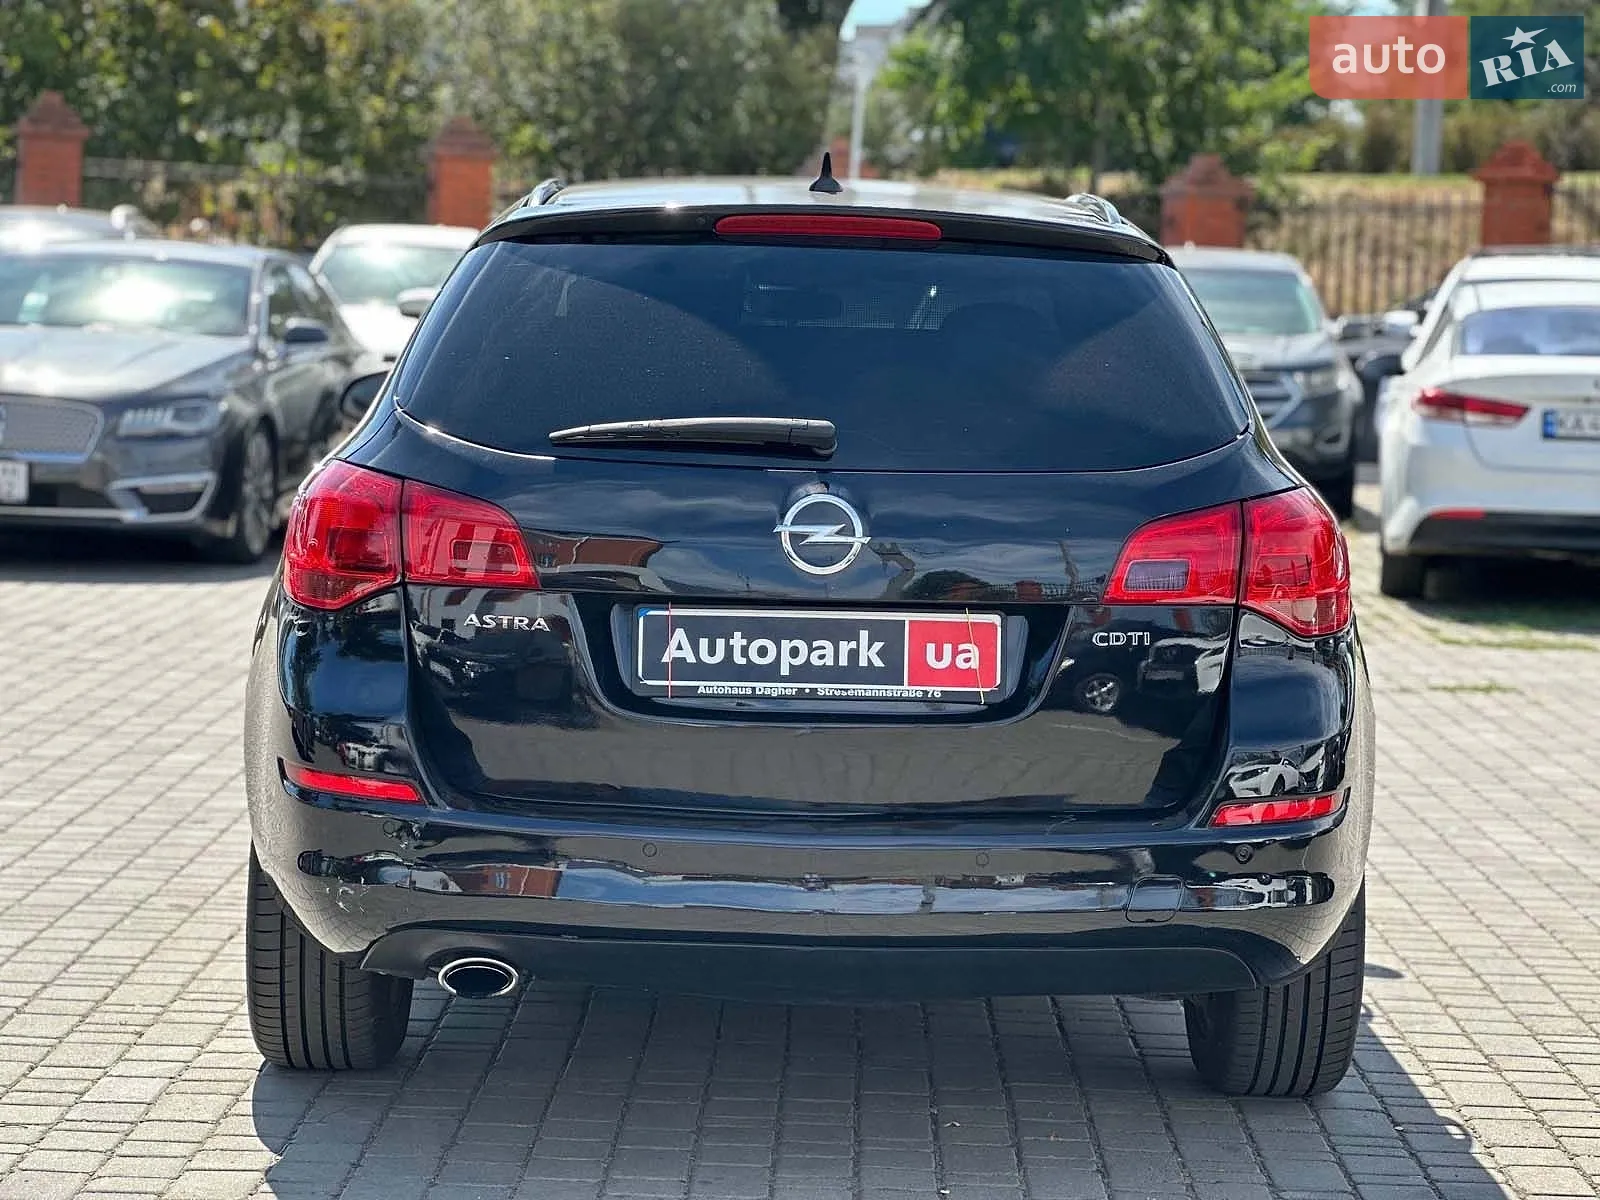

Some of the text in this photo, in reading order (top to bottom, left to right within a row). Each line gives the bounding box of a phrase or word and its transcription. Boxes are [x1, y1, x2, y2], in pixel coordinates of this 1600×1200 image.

[463, 613, 551, 632] ASTRA
[1092, 631, 1150, 647] CDTI
[661, 628, 981, 676] Autopark ua
[697, 685, 753, 696] Autohaus
[756, 686, 799, 698] Dagher
